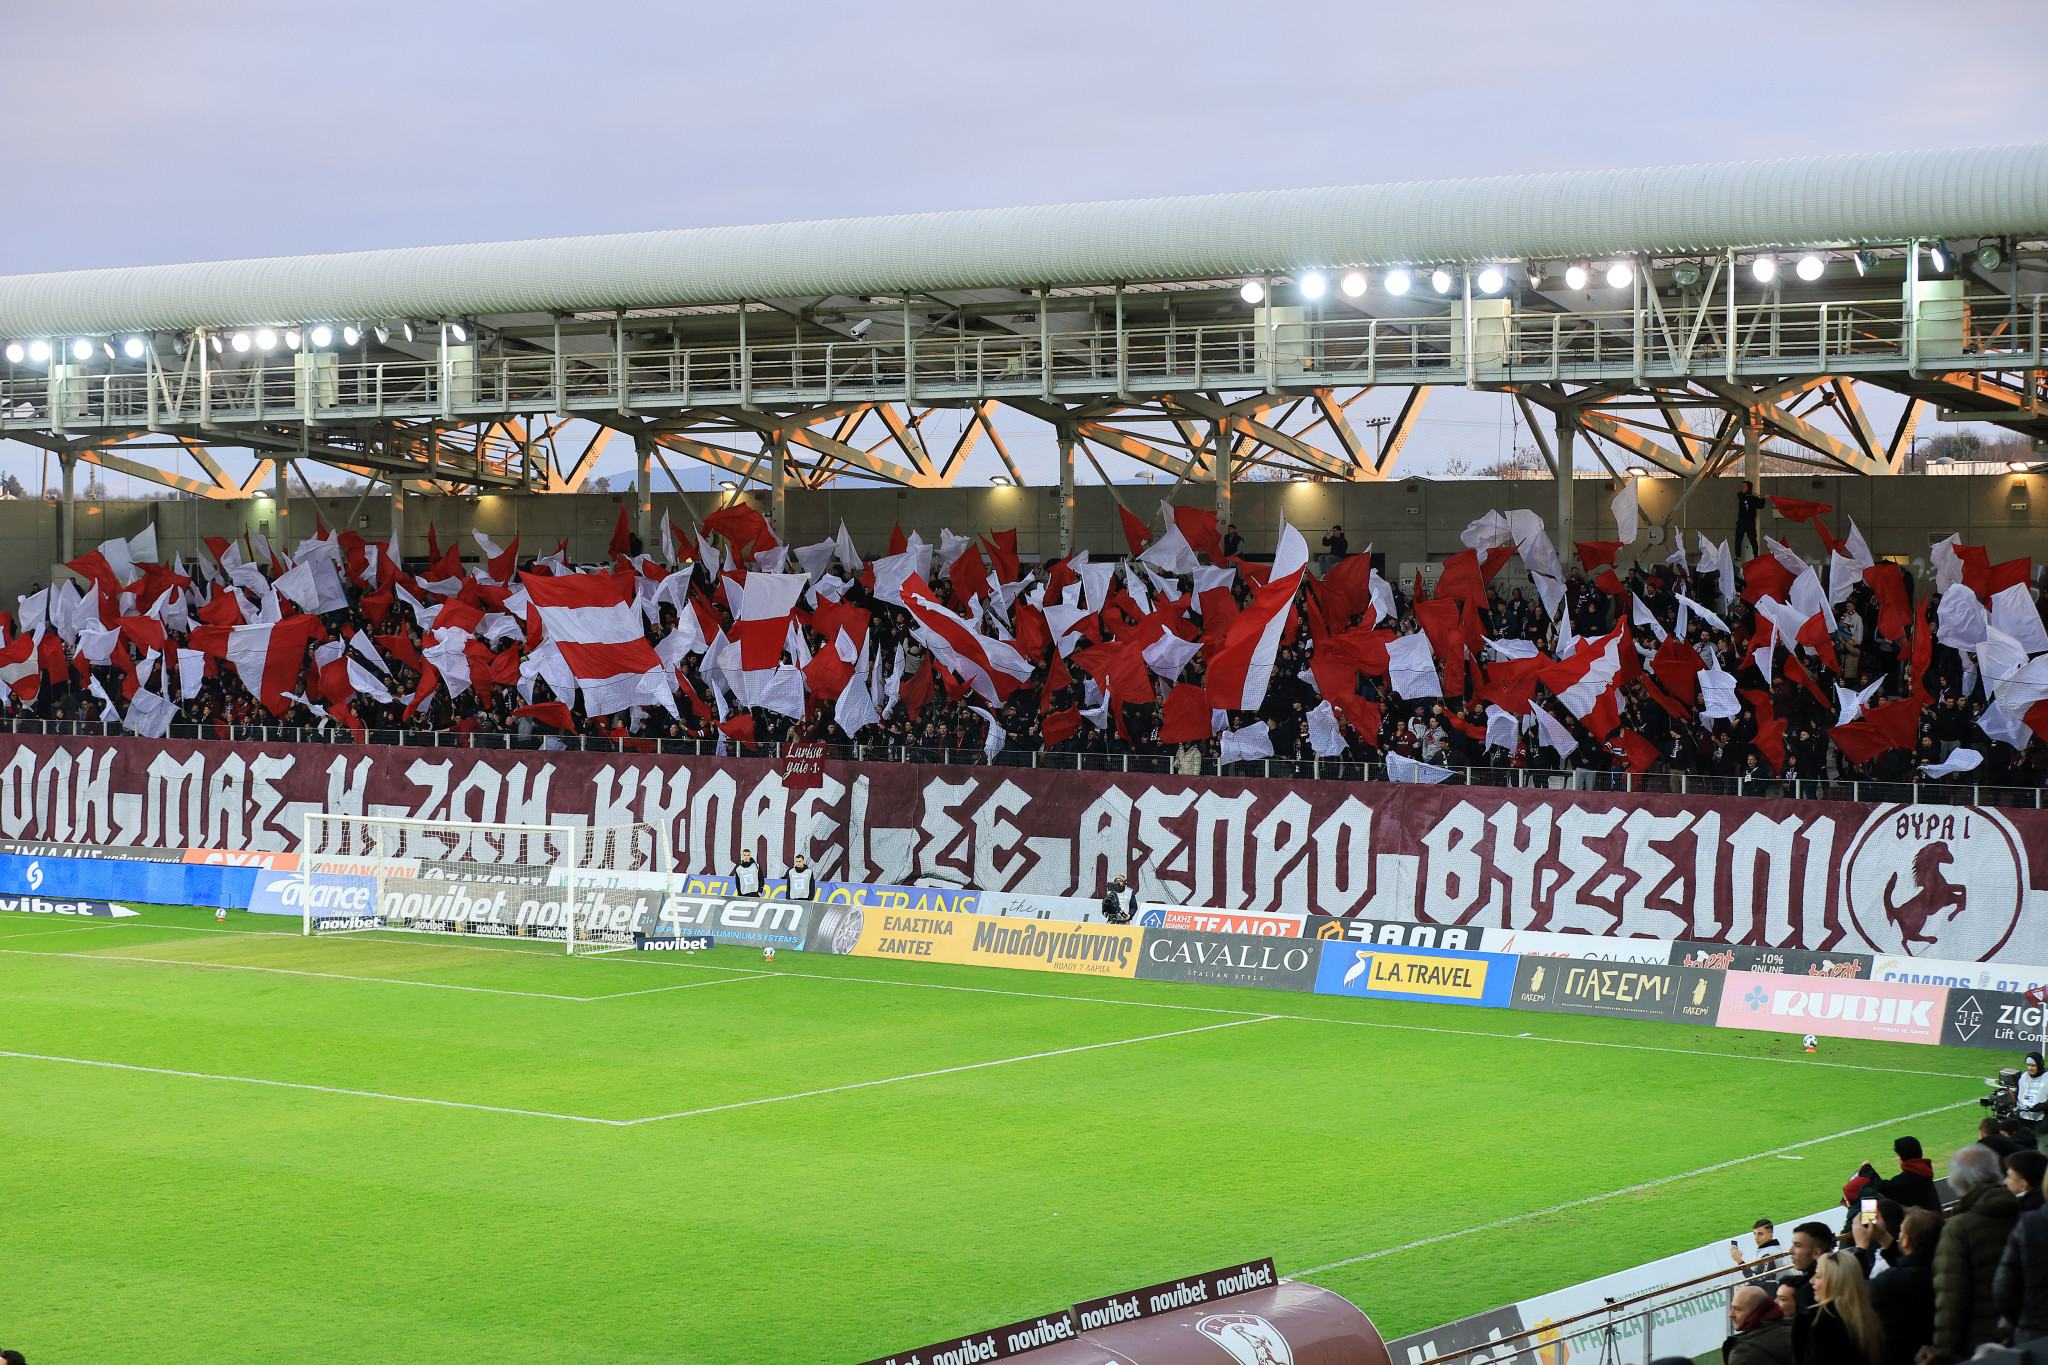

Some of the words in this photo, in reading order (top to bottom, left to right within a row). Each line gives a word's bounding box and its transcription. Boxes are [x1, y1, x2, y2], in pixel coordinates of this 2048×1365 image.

[785, 742, 824, 759] Larissa
[782, 759, 809, 781] gate
[1896, 813, 1955, 840] ΘΥΡΑ
[384, 885, 508, 923] novibet
[1009, 899, 1038, 913] the
[641, 915, 654, 925] 21+
[659, 897, 804, 931] ETEM
[1167, 913, 1192, 923] ΣΑΚΗΣ
[320, 916, 382, 930] novibet
[415, 920, 447, 931] novibet
[476, 923, 509, 935] novibet
[883, 915, 953, 936] ΕΛΑΣΤΙΚΑ
[705, 929, 756, 940] ALUMINIUM
[757, 933, 798, 943] SYSTEMS
[643, 937, 708, 951] novibet
[877, 937, 934, 956] ΖΑΝΤΕΣ
[972, 920, 1133, 969] Μπαλογιάννης
[1755, 954, 1784, 964] -10%
[1053, 962, 1078, 972] ΒΟΛΟΥ
[1751, 964, 1785, 974] ONLINE
[1187, 970, 1229, 979] ITALIAN
[1234, 973, 1265, 982] STYLE
[1375, 961, 1403, 983] L.A.
[1407, 964, 1472, 988] TRAVEL
[1771, 989, 1935, 1027] RUBIK
[1994, 1028, 2015, 1040] Lift
[1079, 1295, 1141, 1330] novibet
[1149, 1279, 1208, 1313] novibet
[1217, 1262, 1272, 1298] novibet
[1007, 1314, 1072, 1353] novibet
